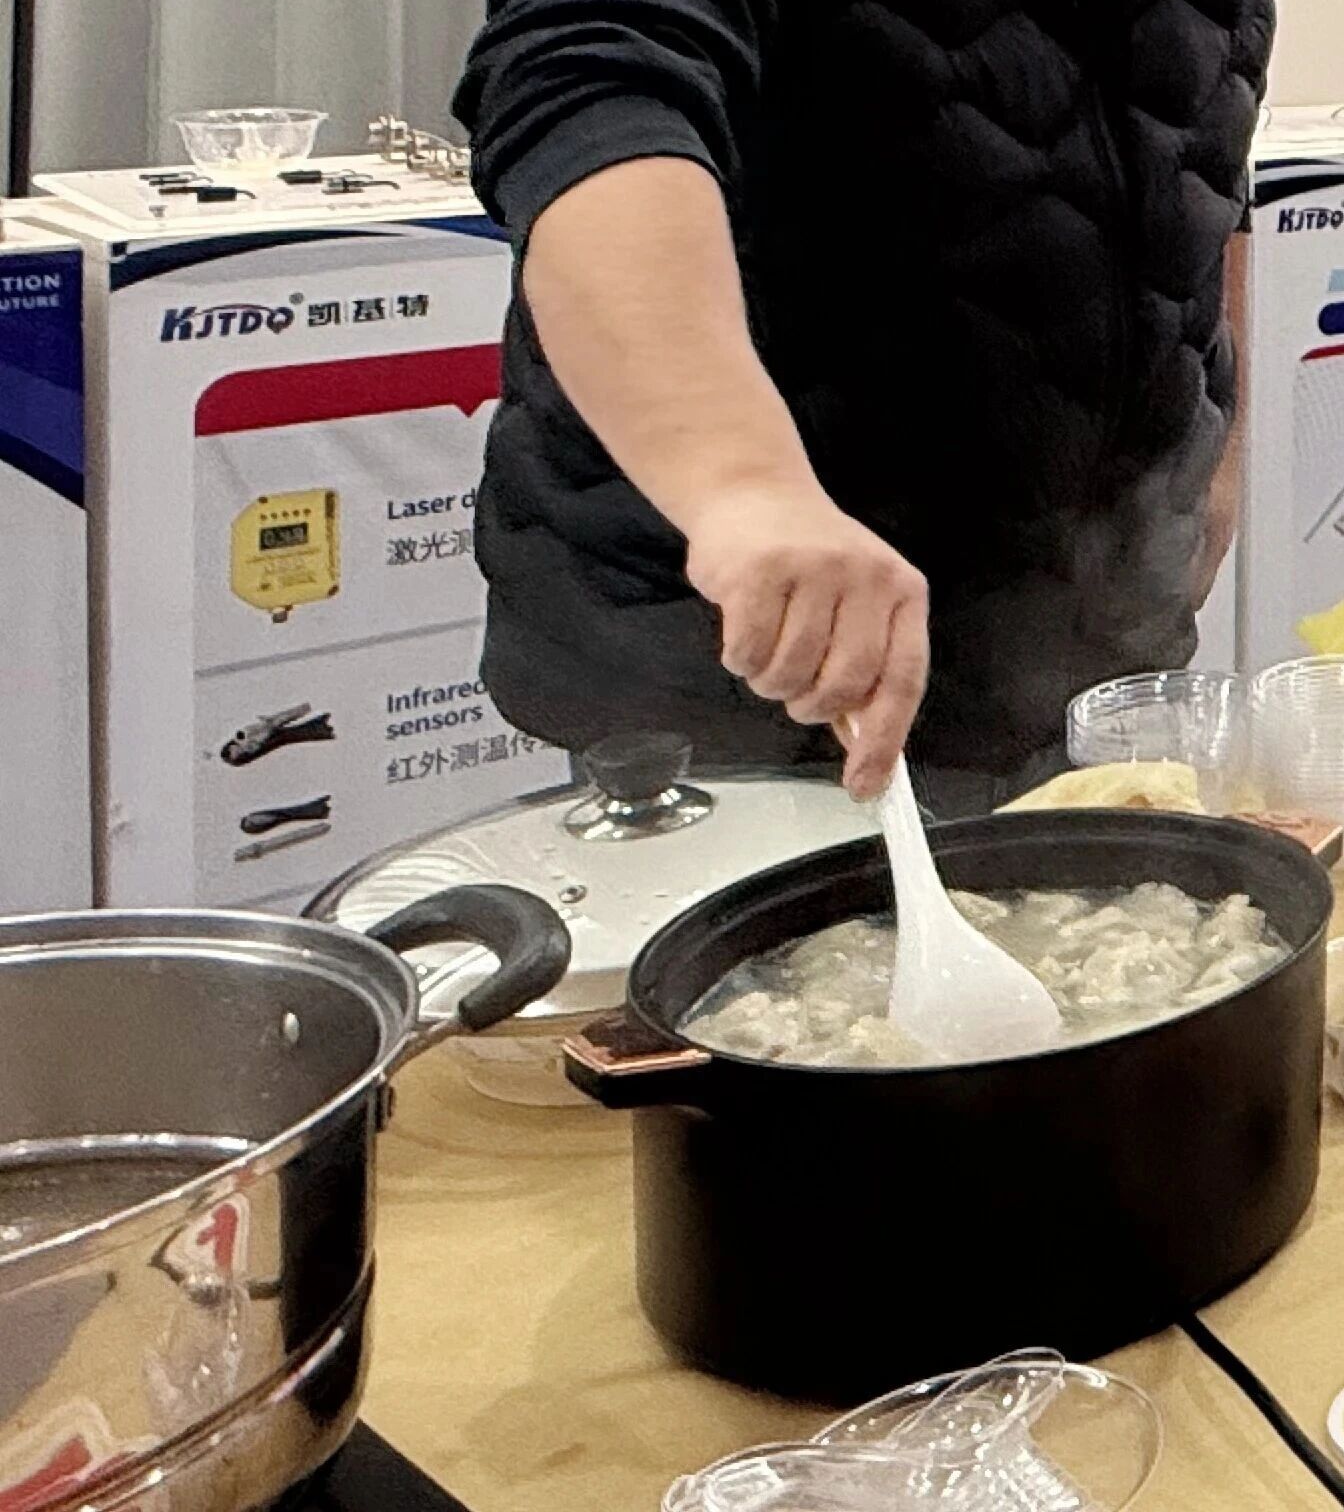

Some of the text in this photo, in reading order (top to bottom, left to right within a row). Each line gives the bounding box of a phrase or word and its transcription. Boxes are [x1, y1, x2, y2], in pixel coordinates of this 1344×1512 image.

[387, 494, 457, 520] Laser
[386, 704, 484, 739] sensors
[386, 731, 553, 784] 红外测温传
